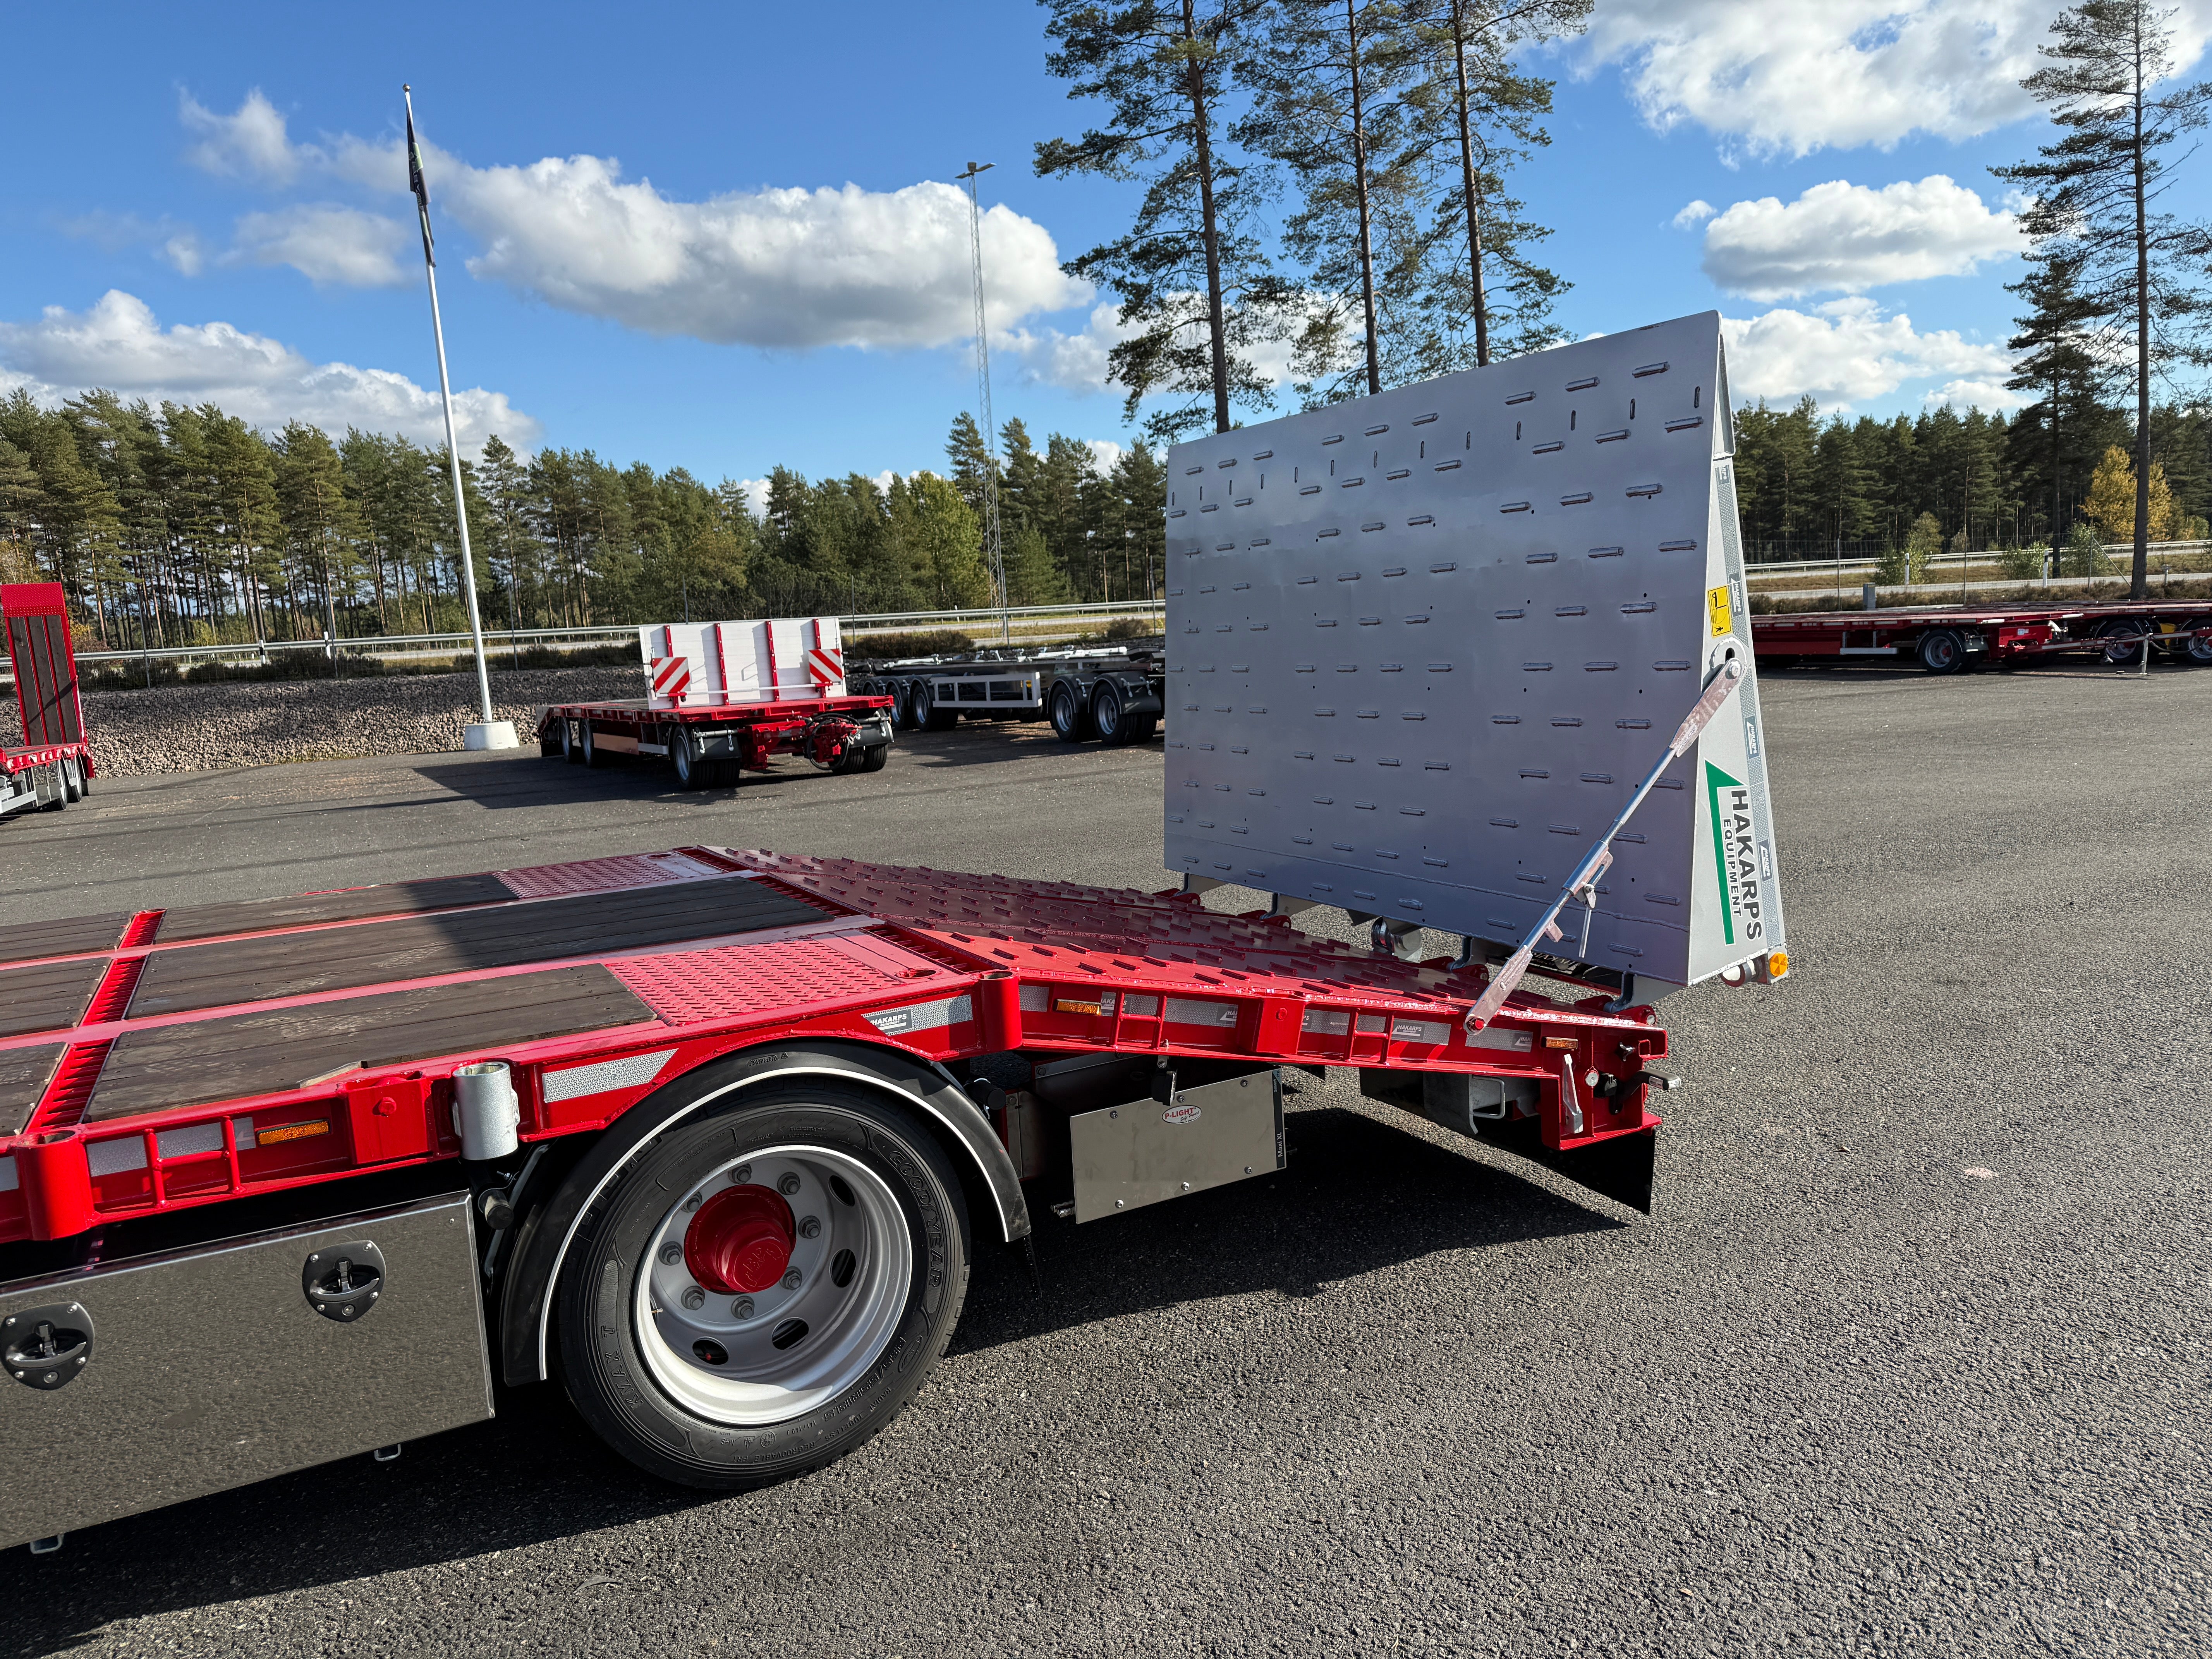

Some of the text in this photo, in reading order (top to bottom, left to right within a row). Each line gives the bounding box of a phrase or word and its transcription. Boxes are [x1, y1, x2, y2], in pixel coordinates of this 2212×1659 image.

[1723, 819, 1741, 917] EQUIPMENT
[1731, 790, 1762, 940] HAKARPS
[872, 1013, 907, 1025] HAKARPS
[1164, 1107, 1194, 1119] P-LIGHT
[1276, 1132, 1282, 1140] XL
[889, 1151, 943, 1288] GOODYEAR
[601, 1324, 615, 1339] T
[605, 1348, 644, 1410] KMAX
[754, 1441, 815, 1462] REGROOVABLE
